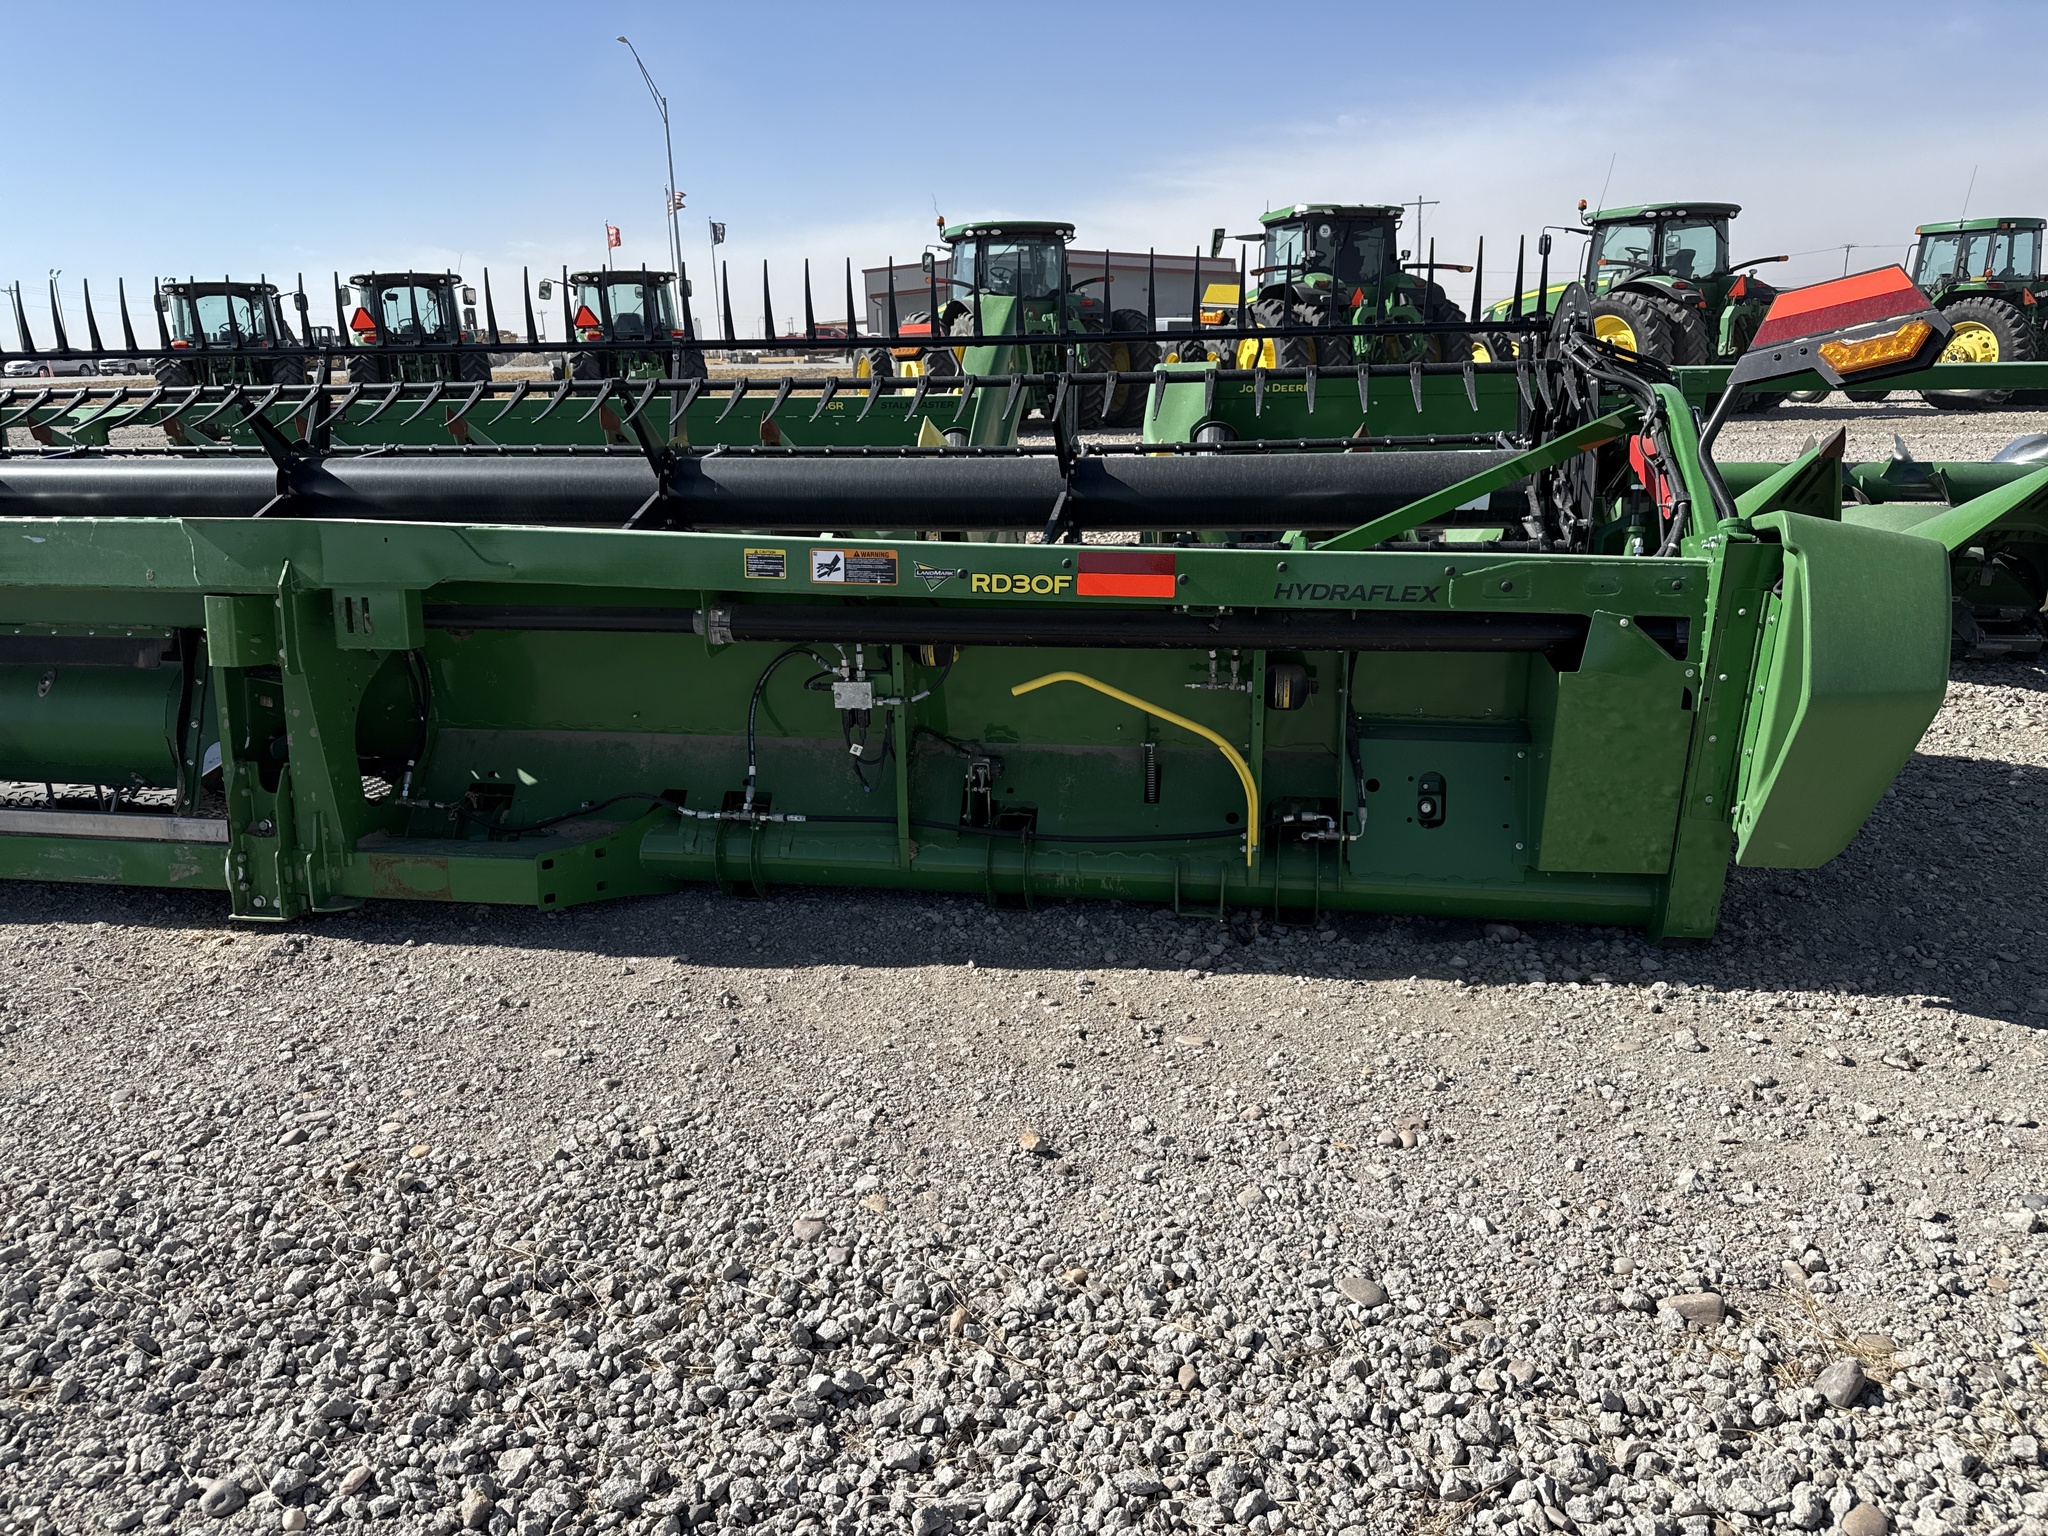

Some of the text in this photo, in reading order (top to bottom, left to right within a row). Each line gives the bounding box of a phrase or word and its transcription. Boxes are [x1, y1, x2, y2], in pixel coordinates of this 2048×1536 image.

[1239, 384, 1270, 393] JON
[881, 400, 955, 410] STALKASTER
[971, 573, 1073, 594] RD30F
[1273, 583, 1442, 603] HYDRAFLEX
